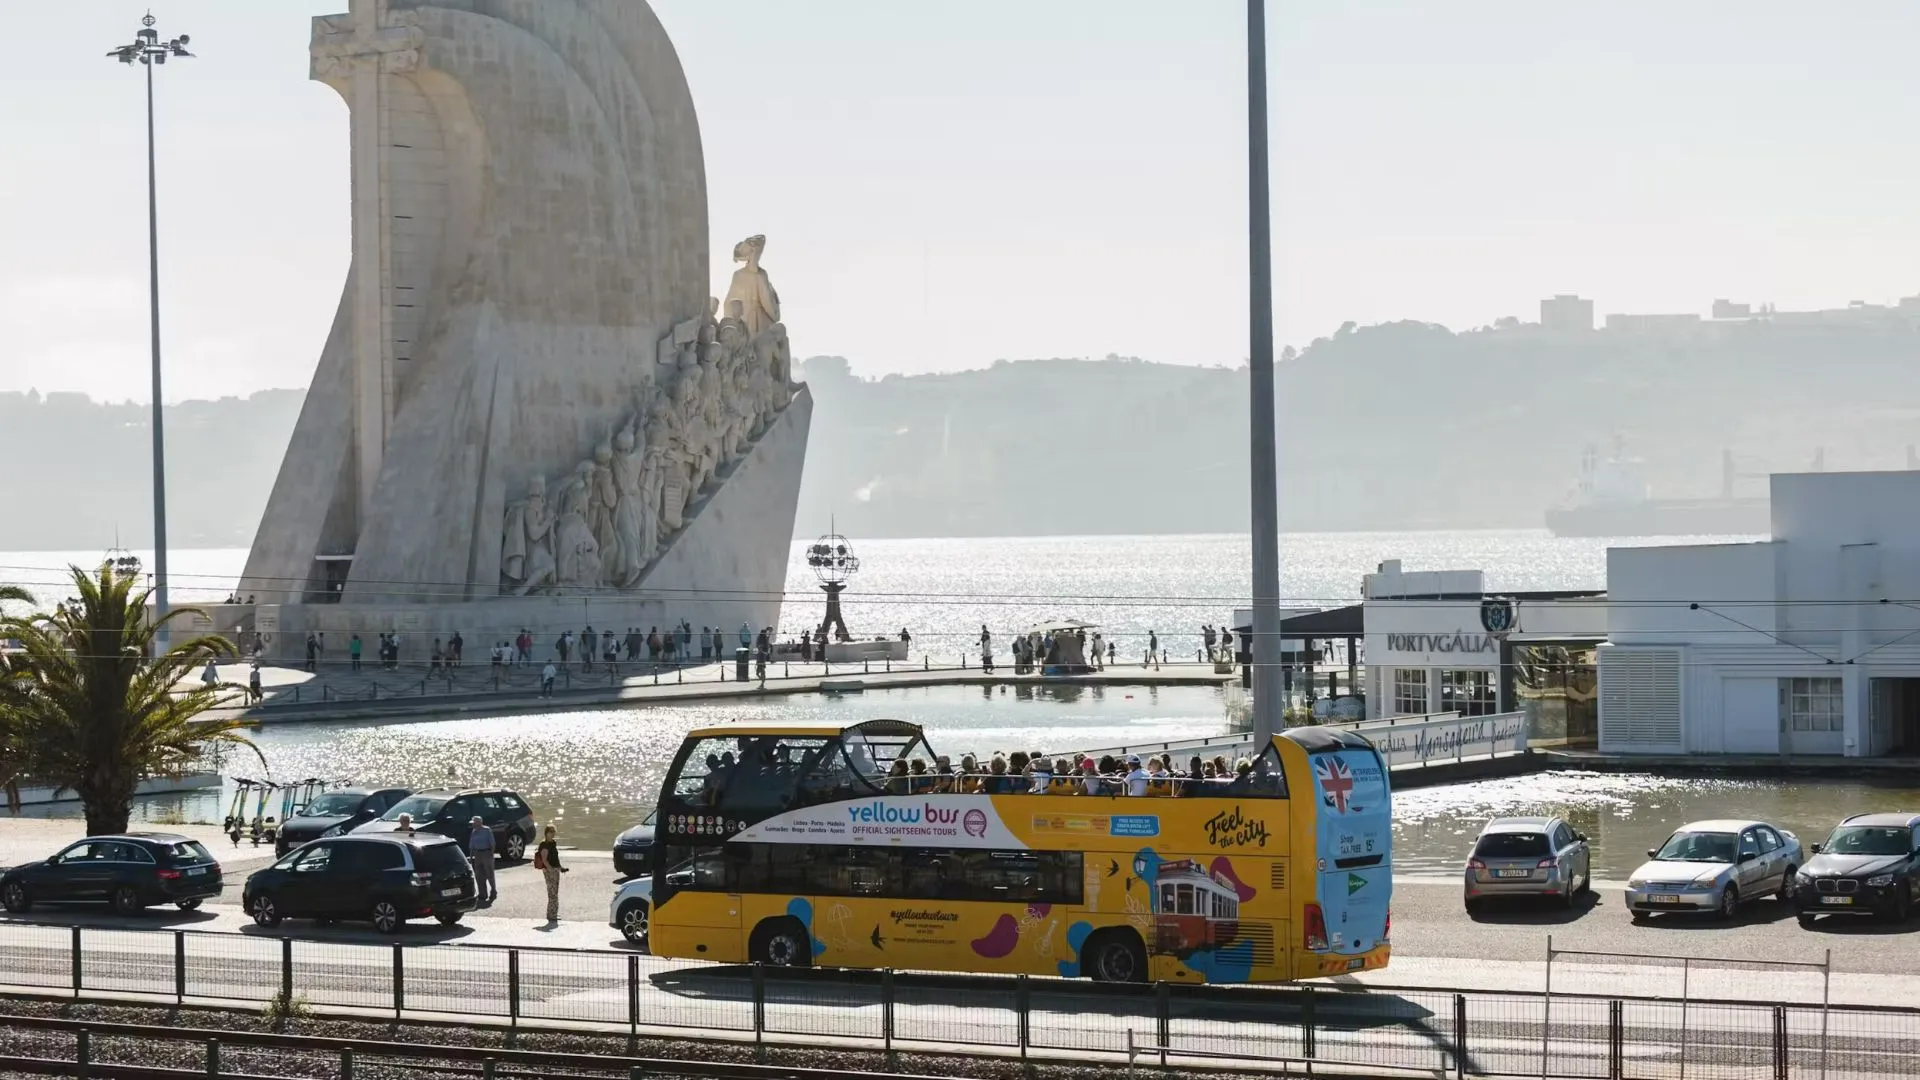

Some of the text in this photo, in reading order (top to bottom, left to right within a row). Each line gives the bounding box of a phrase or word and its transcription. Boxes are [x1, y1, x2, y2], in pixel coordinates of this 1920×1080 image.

[1414, 720, 1485, 760] Marisqueira
[925, 802, 959, 824] bus
[1204, 805, 1244, 845] Feel
[852, 825, 957, 836] OFFICIAL SIGHTSEEING TOURS
[1218, 819, 1272, 849] the city
